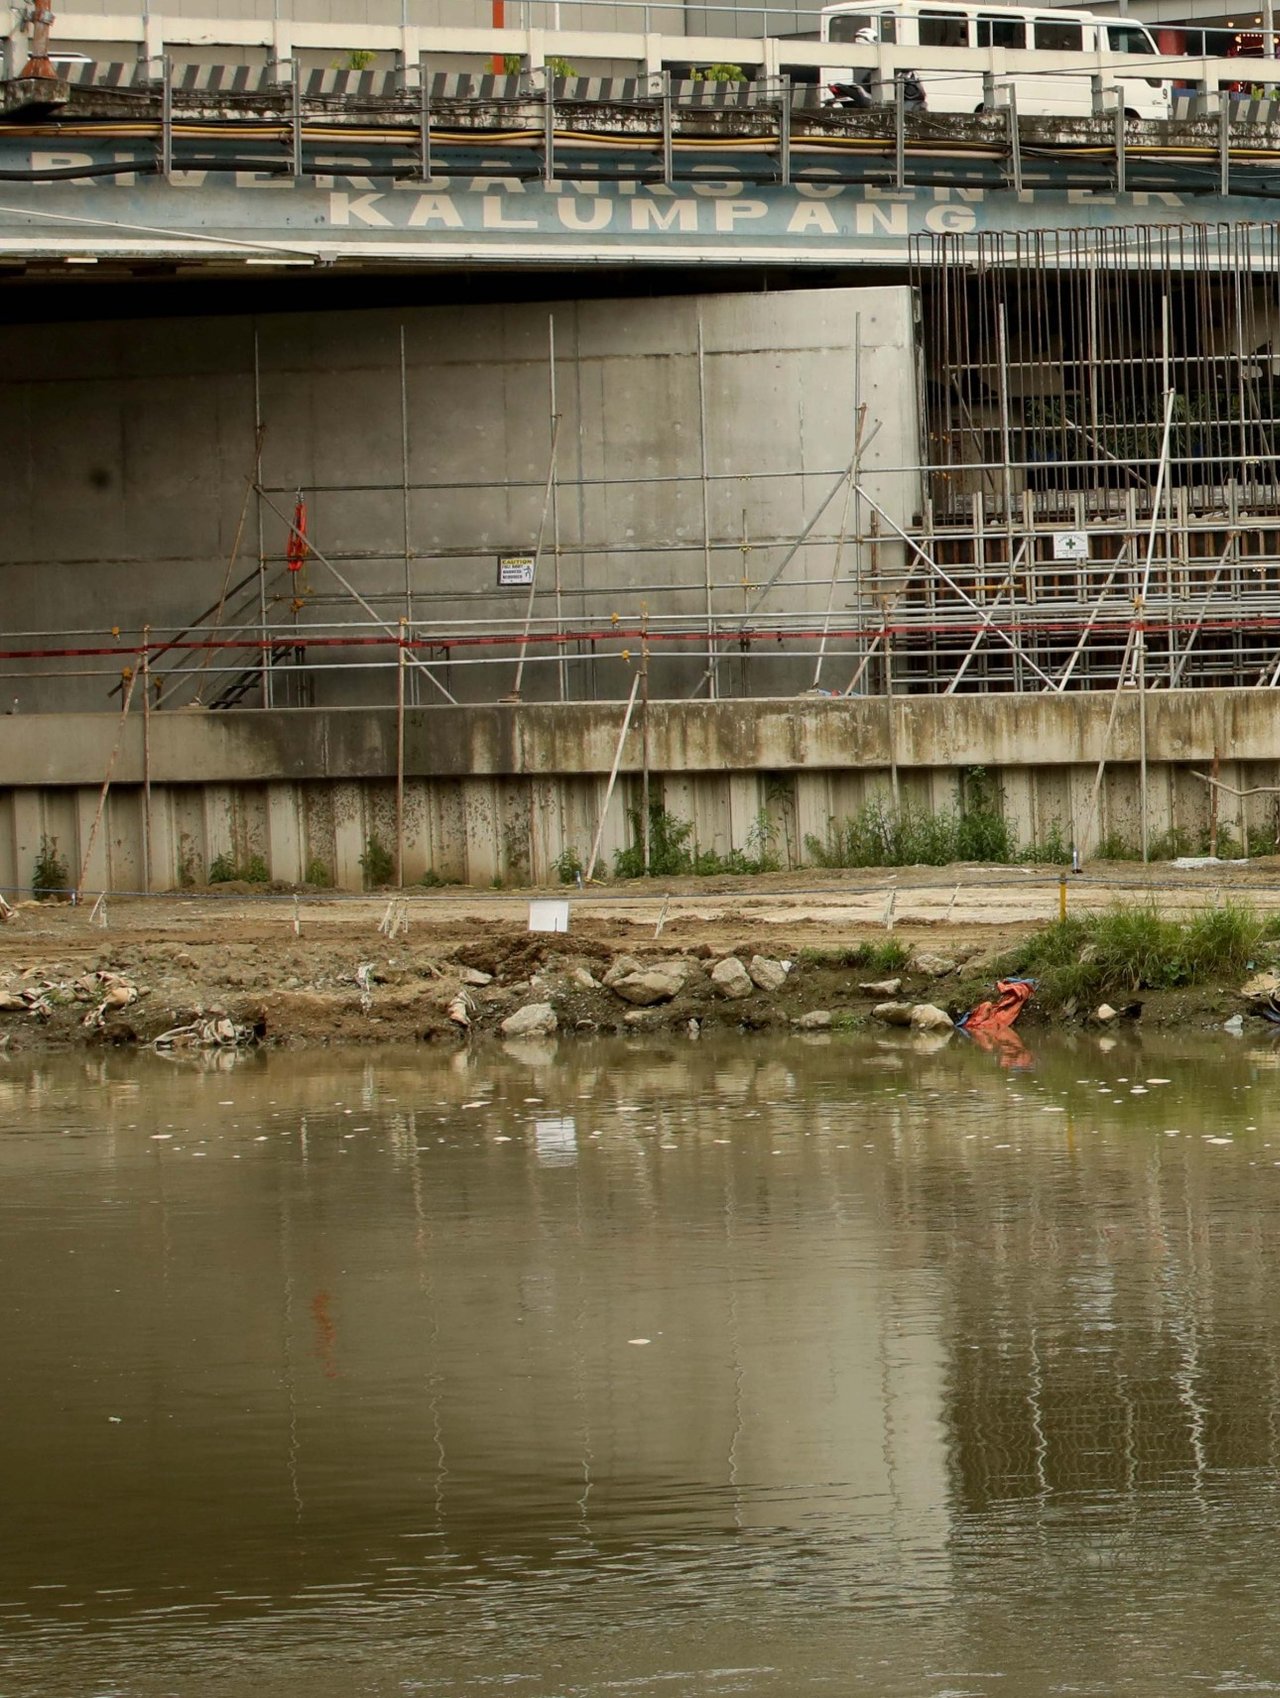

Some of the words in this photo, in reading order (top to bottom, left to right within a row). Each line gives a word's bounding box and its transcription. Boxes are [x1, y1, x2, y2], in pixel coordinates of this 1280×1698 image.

[31, 151, 745, 197] RIVERBANKS
[794, 167, 1187, 206] CENTER
[329, 191, 977, 234] KALUMPANG
